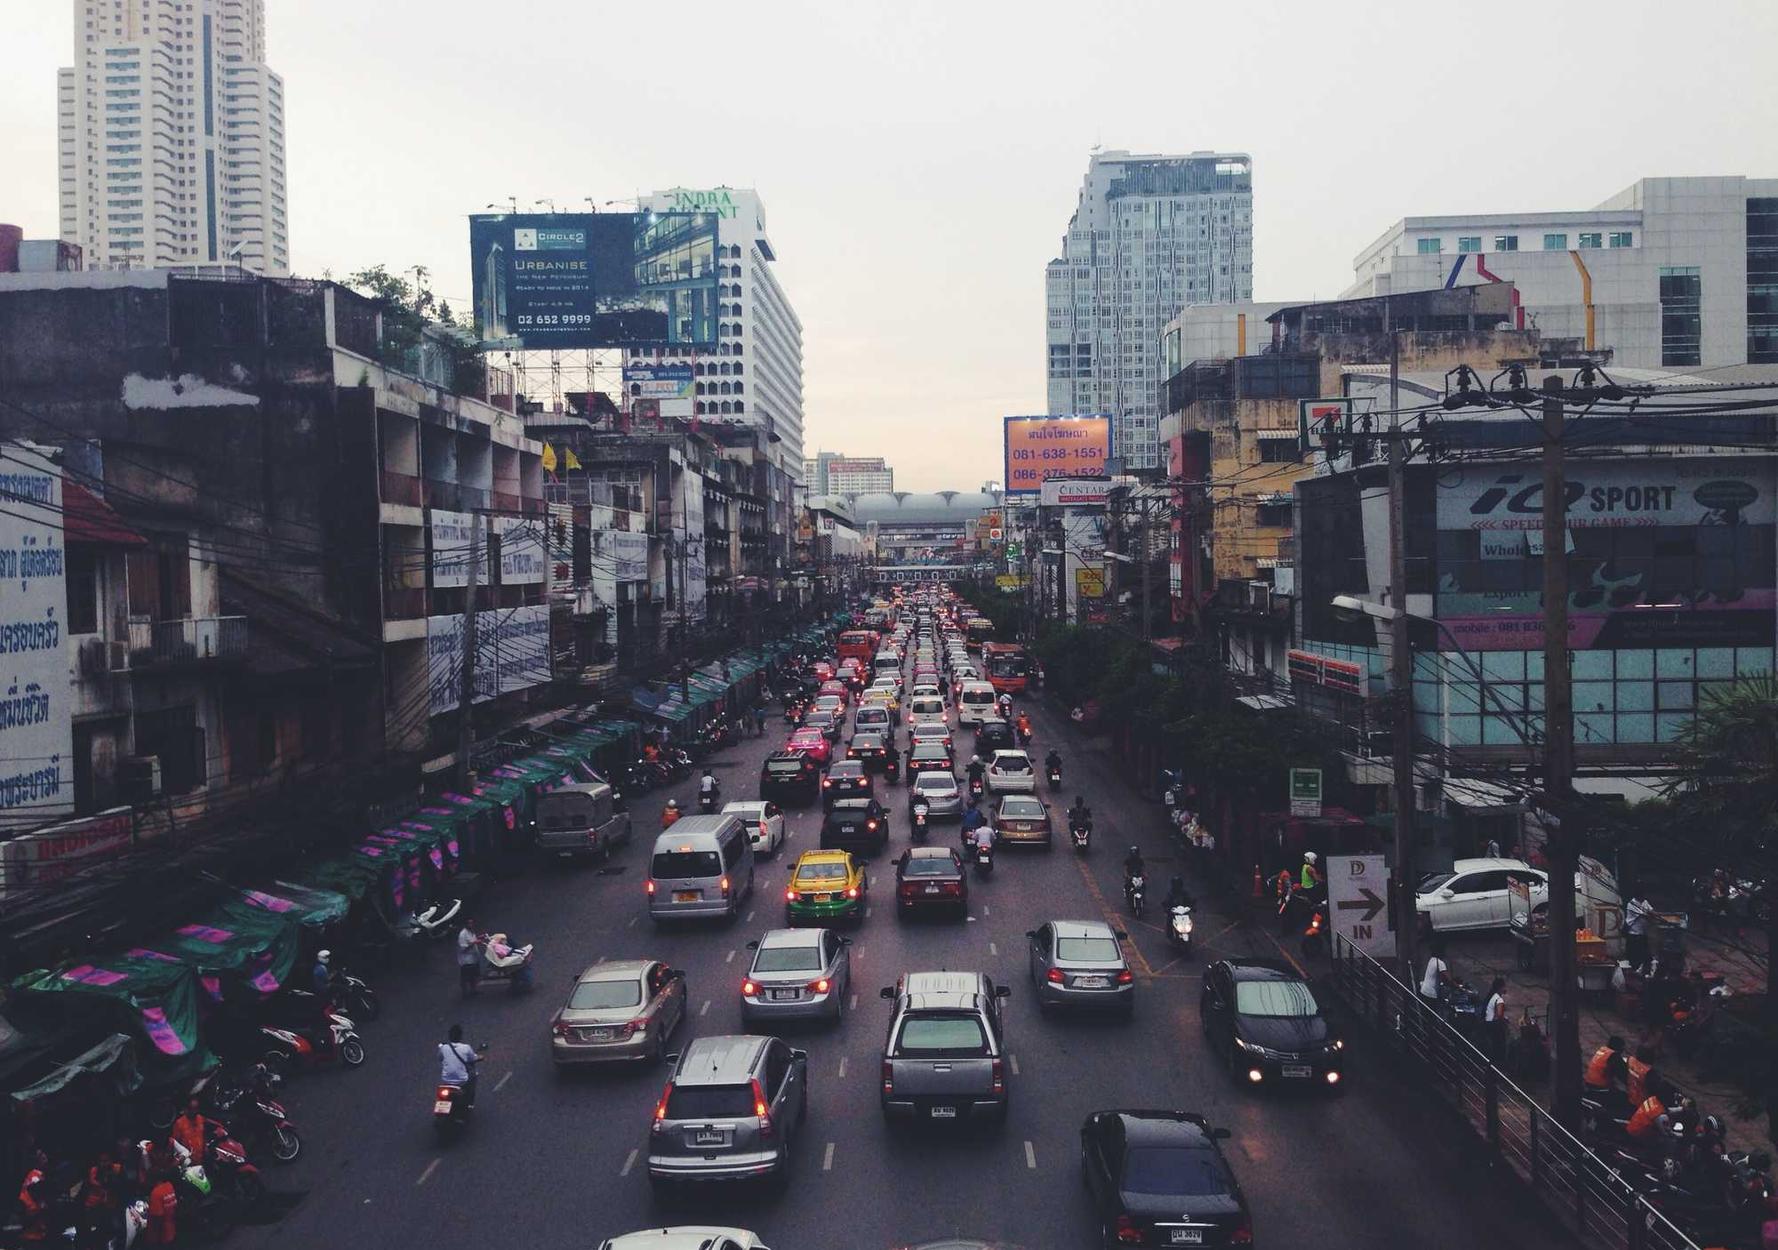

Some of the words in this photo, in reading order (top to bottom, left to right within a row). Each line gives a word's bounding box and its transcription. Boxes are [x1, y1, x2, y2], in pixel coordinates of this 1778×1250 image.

[675, 192, 732, 205] INDRA
[514, 260, 588, 270] URBANISE
[518, 315, 533, 324] 02
[536, 315, 559, 324] 652
[562, 315, 591, 324] 9999
[1013, 448, 1104, 460] 081-638-1551
[1590, 486, 1676, 512] SPORT
[1353, 925, 1372, 939] IN
